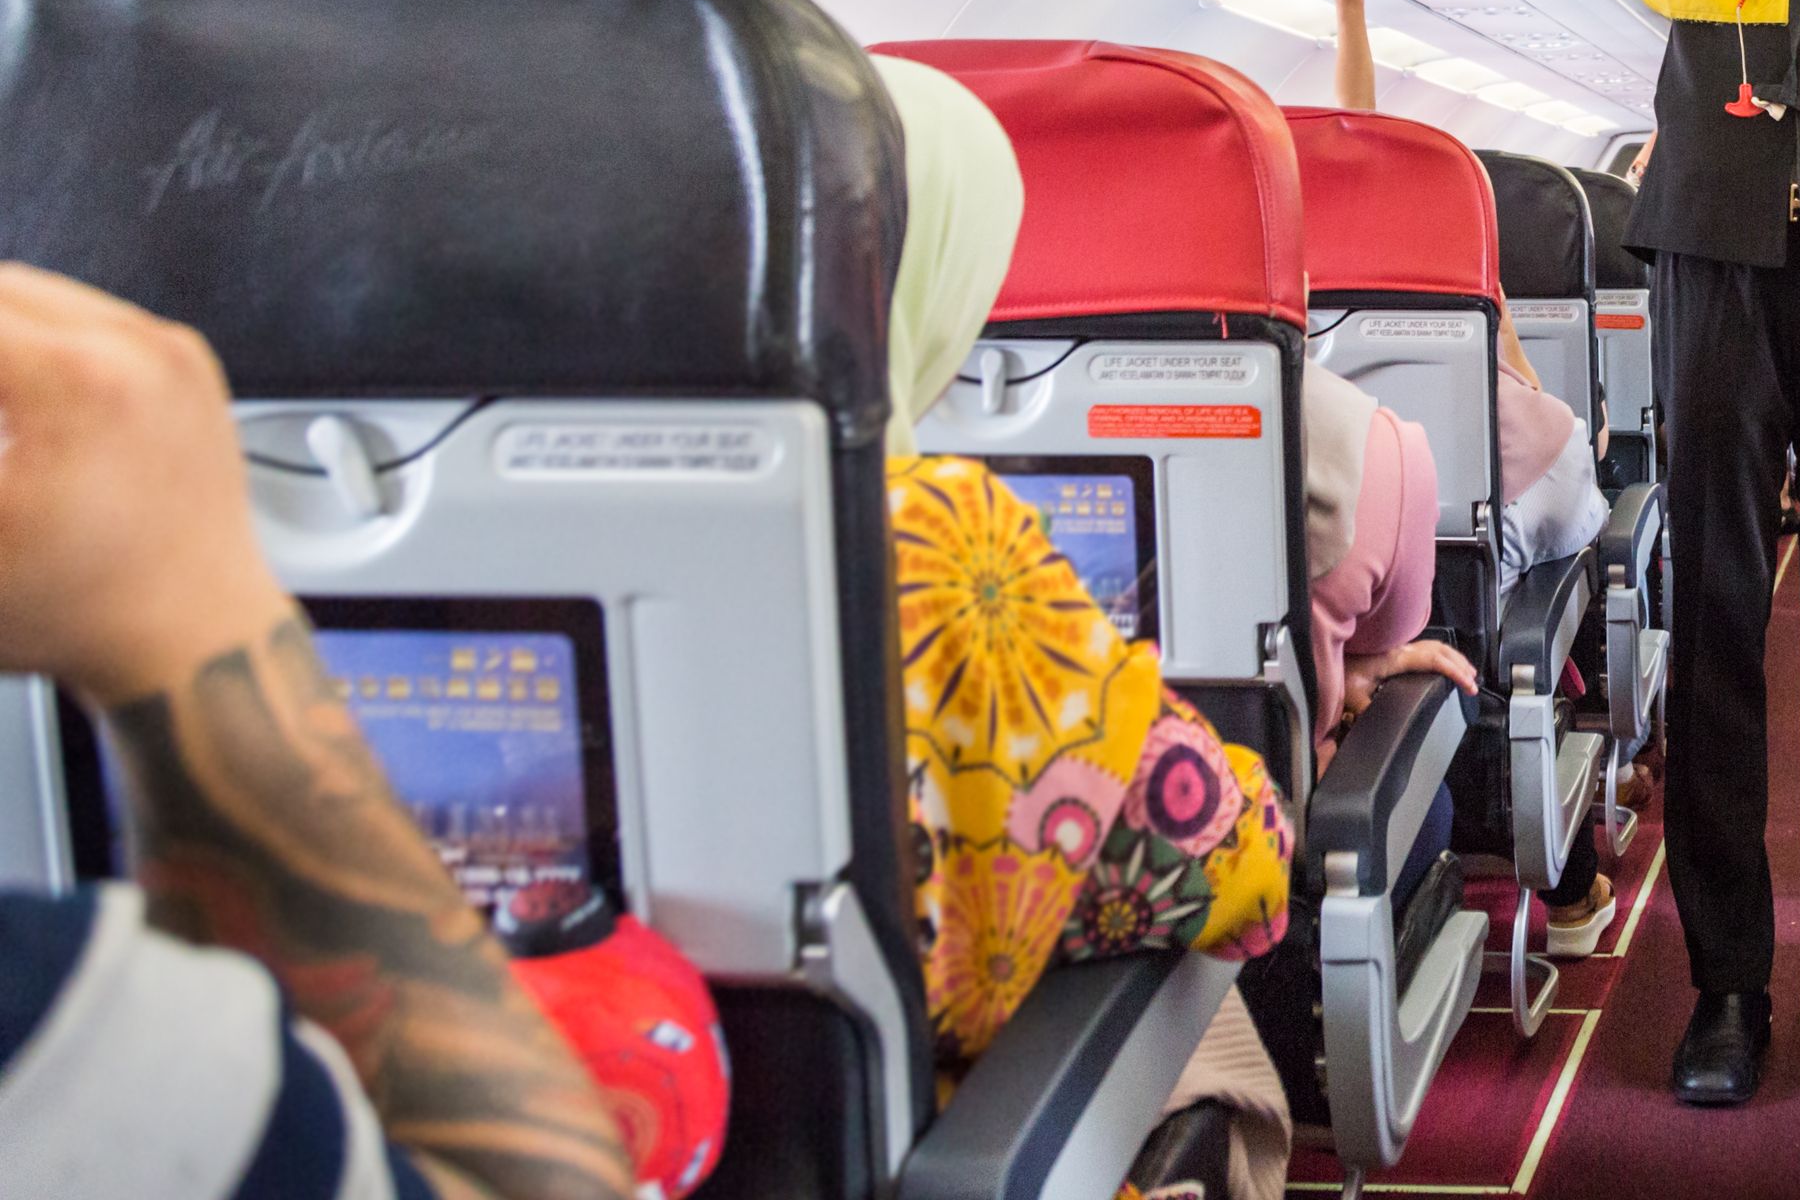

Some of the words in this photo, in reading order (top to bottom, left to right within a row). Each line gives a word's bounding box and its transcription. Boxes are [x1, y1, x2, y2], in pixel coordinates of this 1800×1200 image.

[1104, 357, 1122, 368] LIFE
[1127, 357, 1158, 368] JACKET
[1160, 357, 1190, 368] UNDER
[1193, 357, 1217, 368] YOUR
[1219, 357, 1243, 368] SEAT
